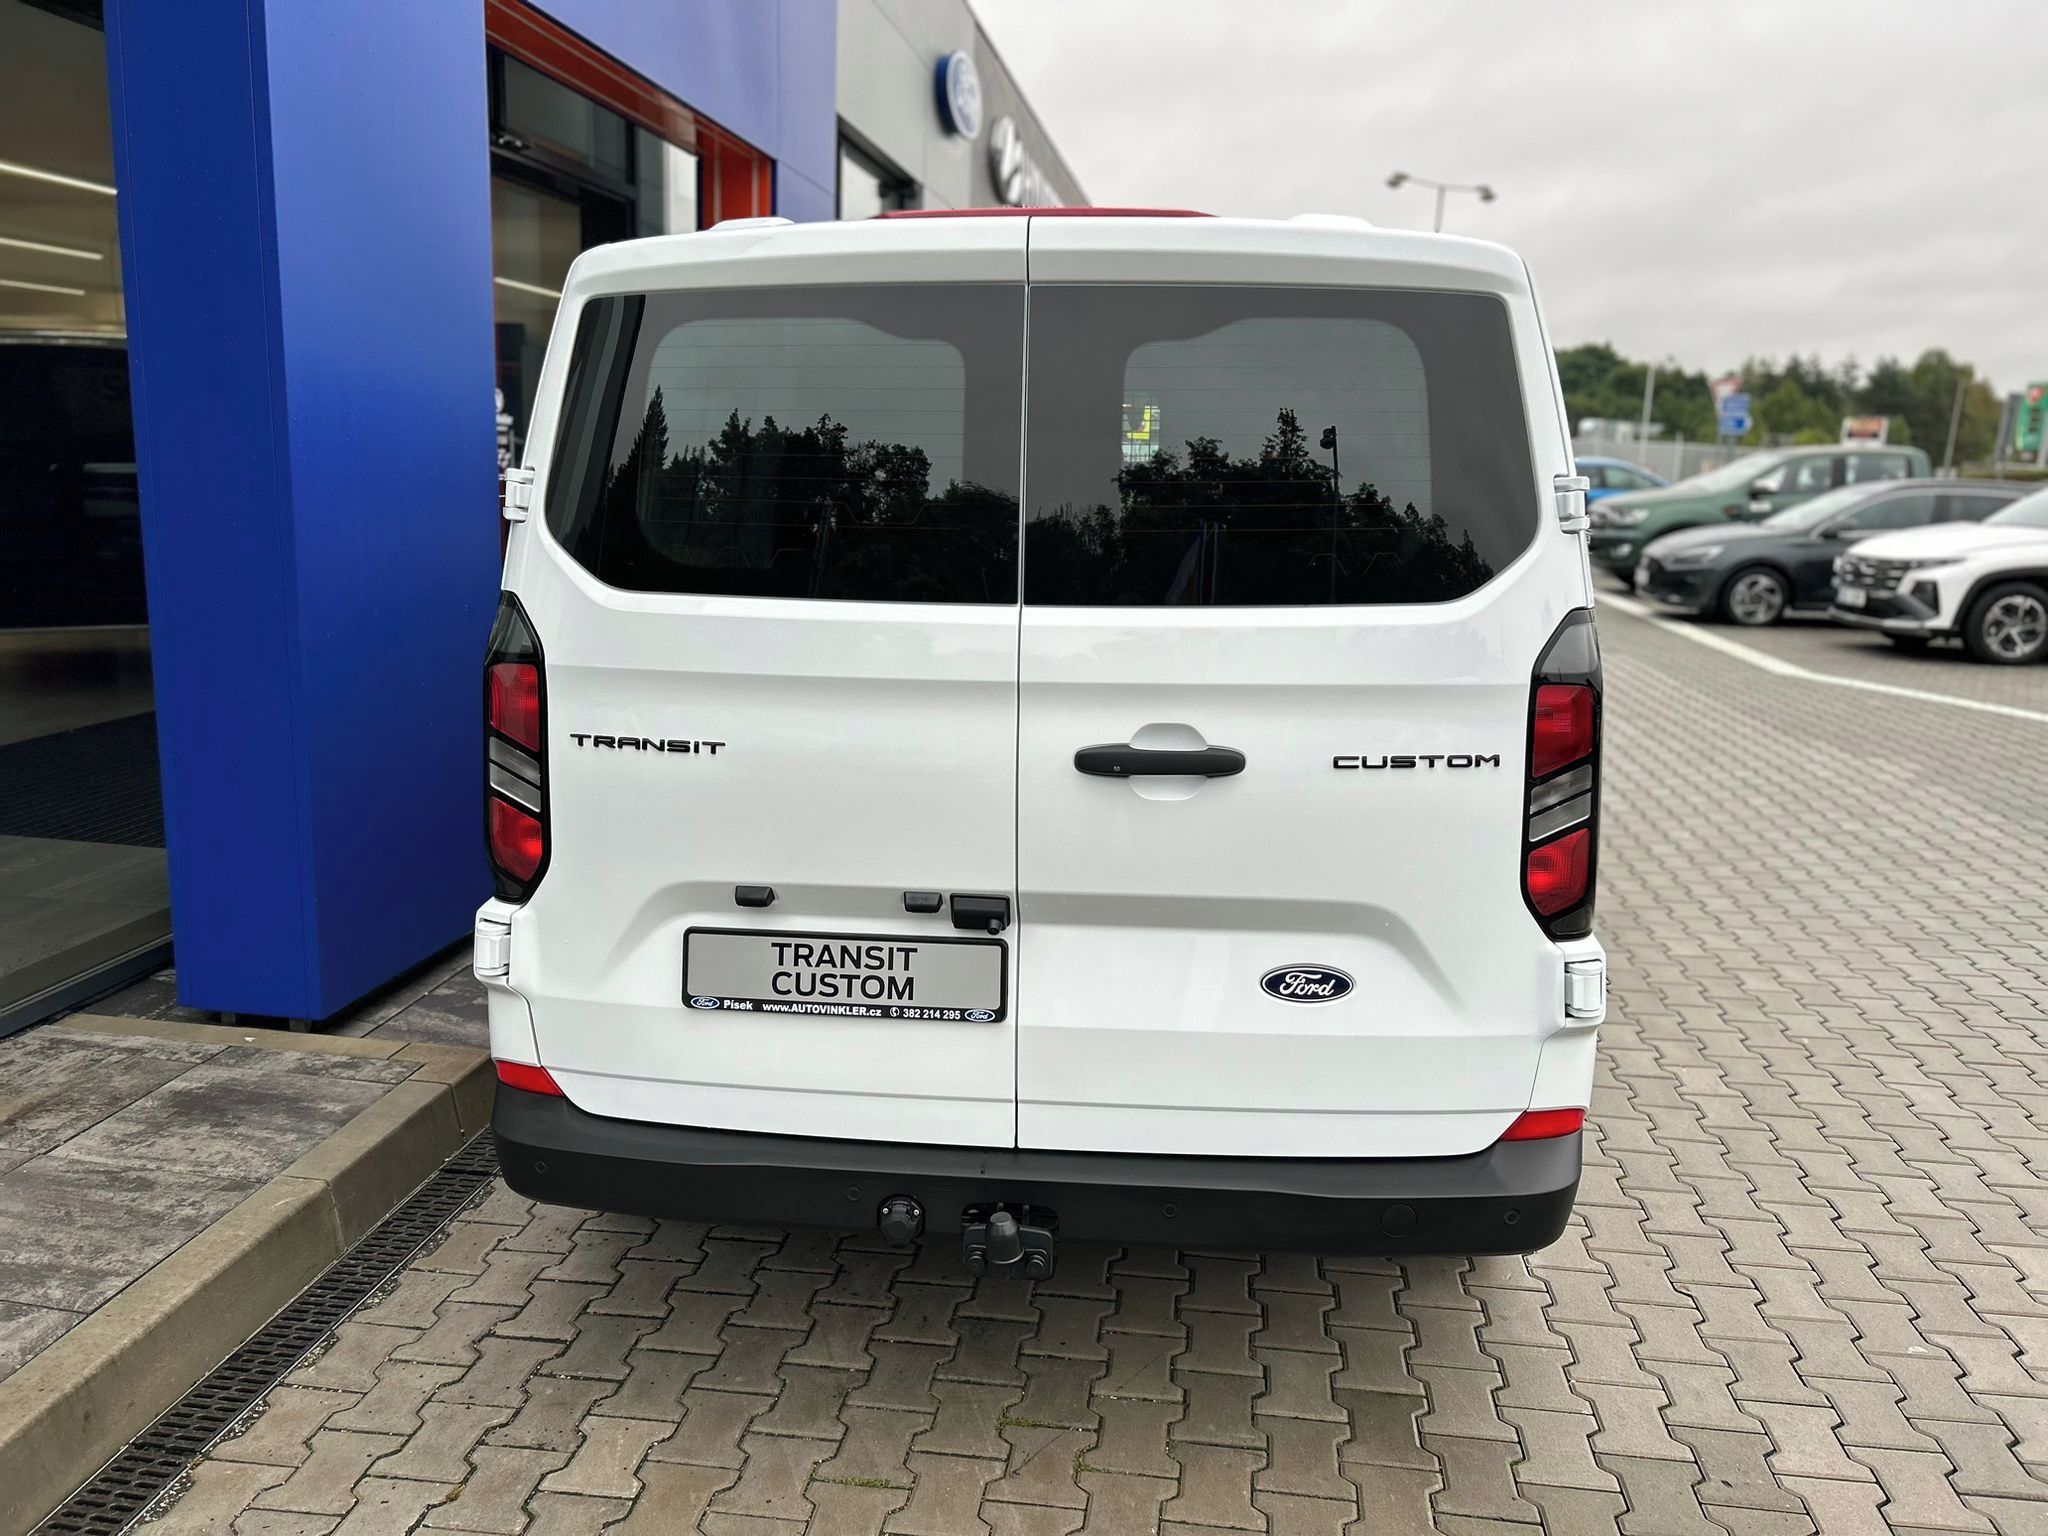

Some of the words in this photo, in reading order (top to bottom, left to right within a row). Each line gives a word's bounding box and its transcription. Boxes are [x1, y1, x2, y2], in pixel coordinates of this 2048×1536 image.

[569, 733, 726, 755] TRANSIT
[1333, 754, 1500, 769] CUSTOM
[771, 942, 918, 971] TRANSIT
[771, 971, 915, 1001] CUSTOM
[1279, 972, 1336, 996] Ford
[762, 1003, 882, 1017] www.AUTOVINKLER.cz
[902, 1008, 920, 1018] 382
[922, 1009, 941, 1019] 214
[943, 1010, 961, 1020] 295
